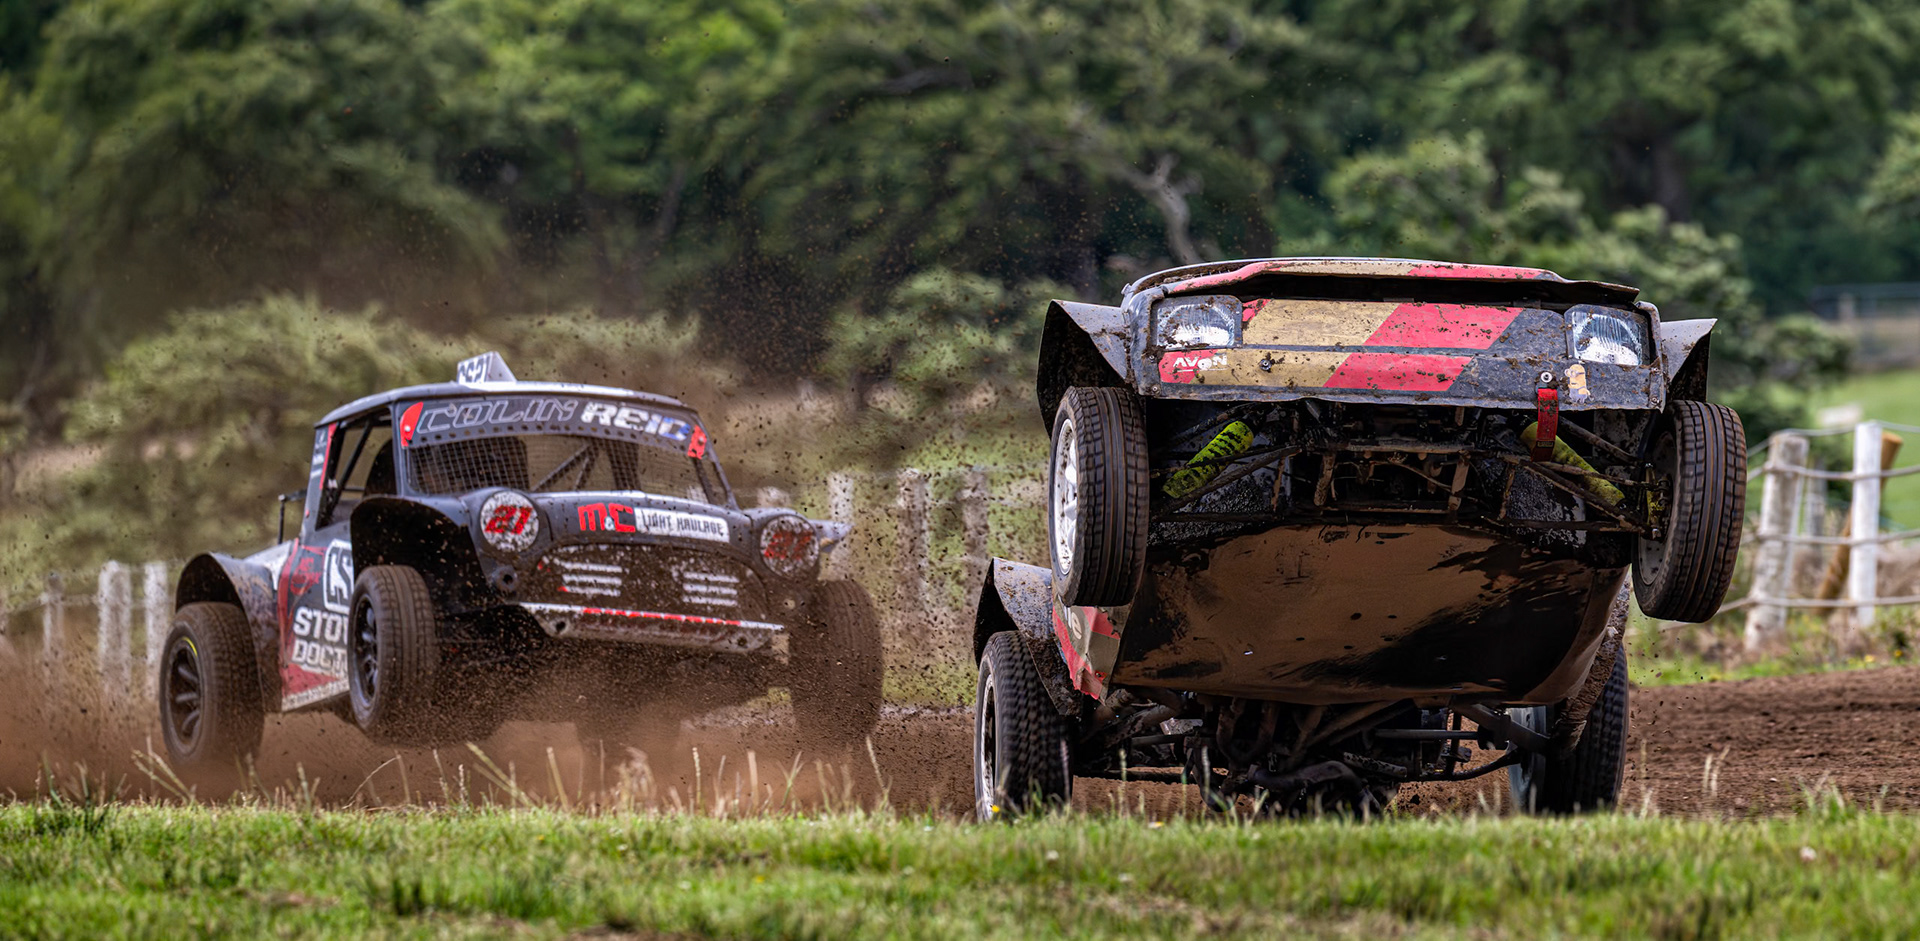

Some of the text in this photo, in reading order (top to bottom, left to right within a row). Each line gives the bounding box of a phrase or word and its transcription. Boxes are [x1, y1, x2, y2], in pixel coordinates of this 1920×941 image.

[1173, 354, 1228, 370] AVON
[416, 399, 692, 441] COLIN REID
[485, 504, 533, 535] 21
[641, 510, 672, 531] LIGHT
[676, 516, 724, 536] HAULAGE
[291, 638, 349, 675] DOCT
